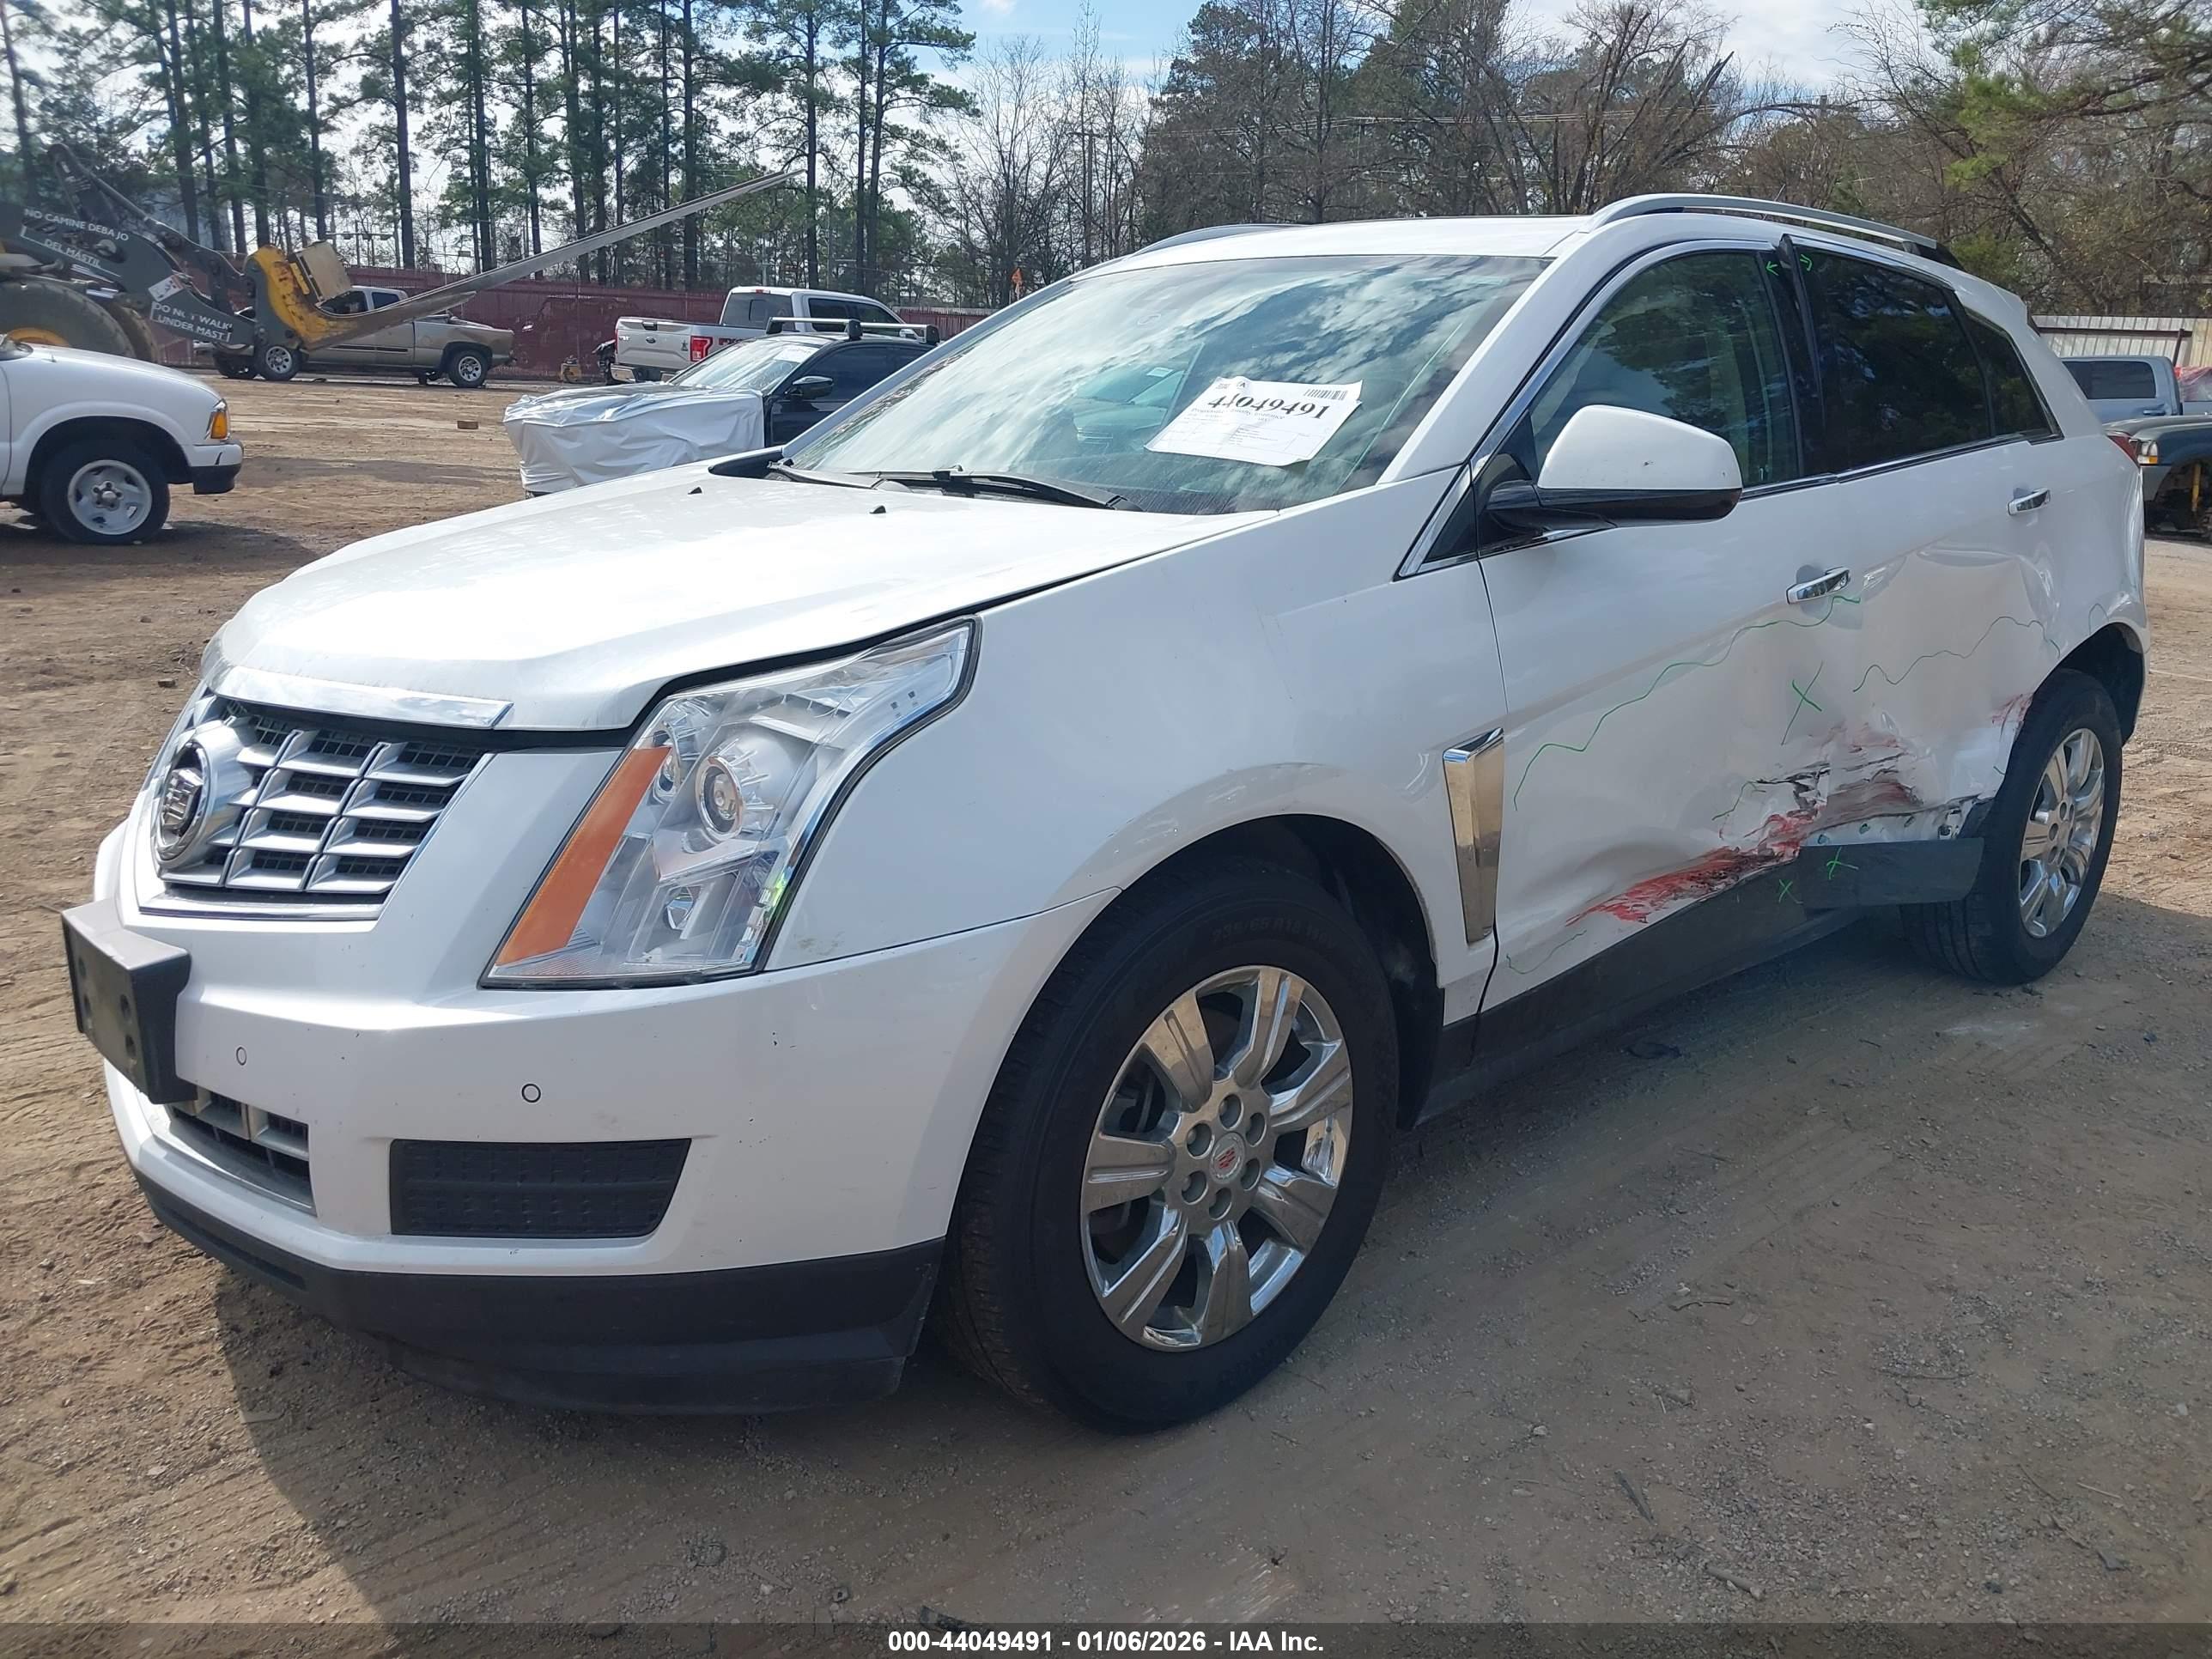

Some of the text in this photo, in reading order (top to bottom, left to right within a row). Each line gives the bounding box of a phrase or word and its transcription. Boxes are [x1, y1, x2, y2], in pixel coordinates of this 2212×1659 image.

[24, 208, 43, 219] NO
[45, 213, 86, 229] CAMINE
[44, 239, 63, 253] DEL
[153, 301, 171, 313] DO
[198, 315, 229, 330] WALK
[156, 314, 226, 340] UNDER MAST
